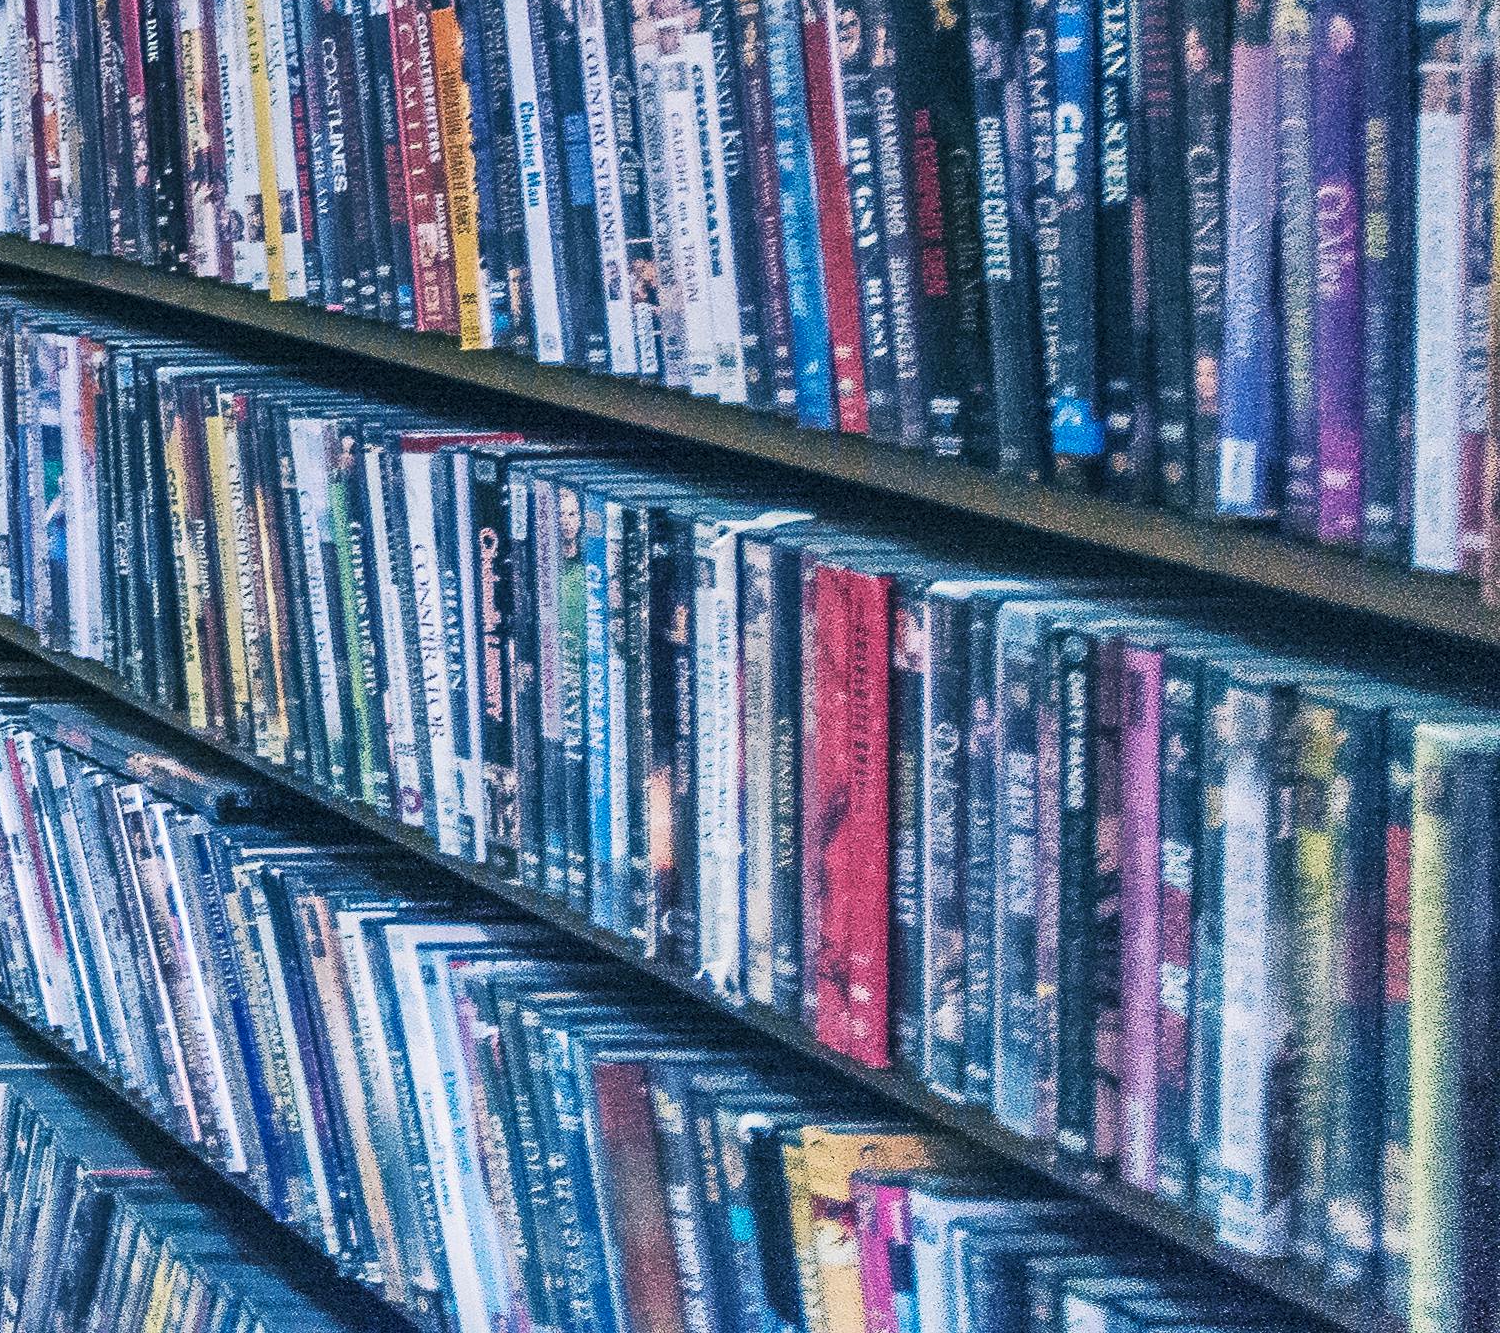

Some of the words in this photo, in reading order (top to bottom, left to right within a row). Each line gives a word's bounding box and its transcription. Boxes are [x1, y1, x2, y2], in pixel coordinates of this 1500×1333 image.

[323, 36, 349, 194] COASTLINES
[584, 29, 606, 144] COUNTRY
[979, 116, 1004, 195] CHINESE
[1103, 121, 1127, 203] SOBER
[594, 155, 616, 256] STRONG
[986, 199, 1011, 281] COFFEE
